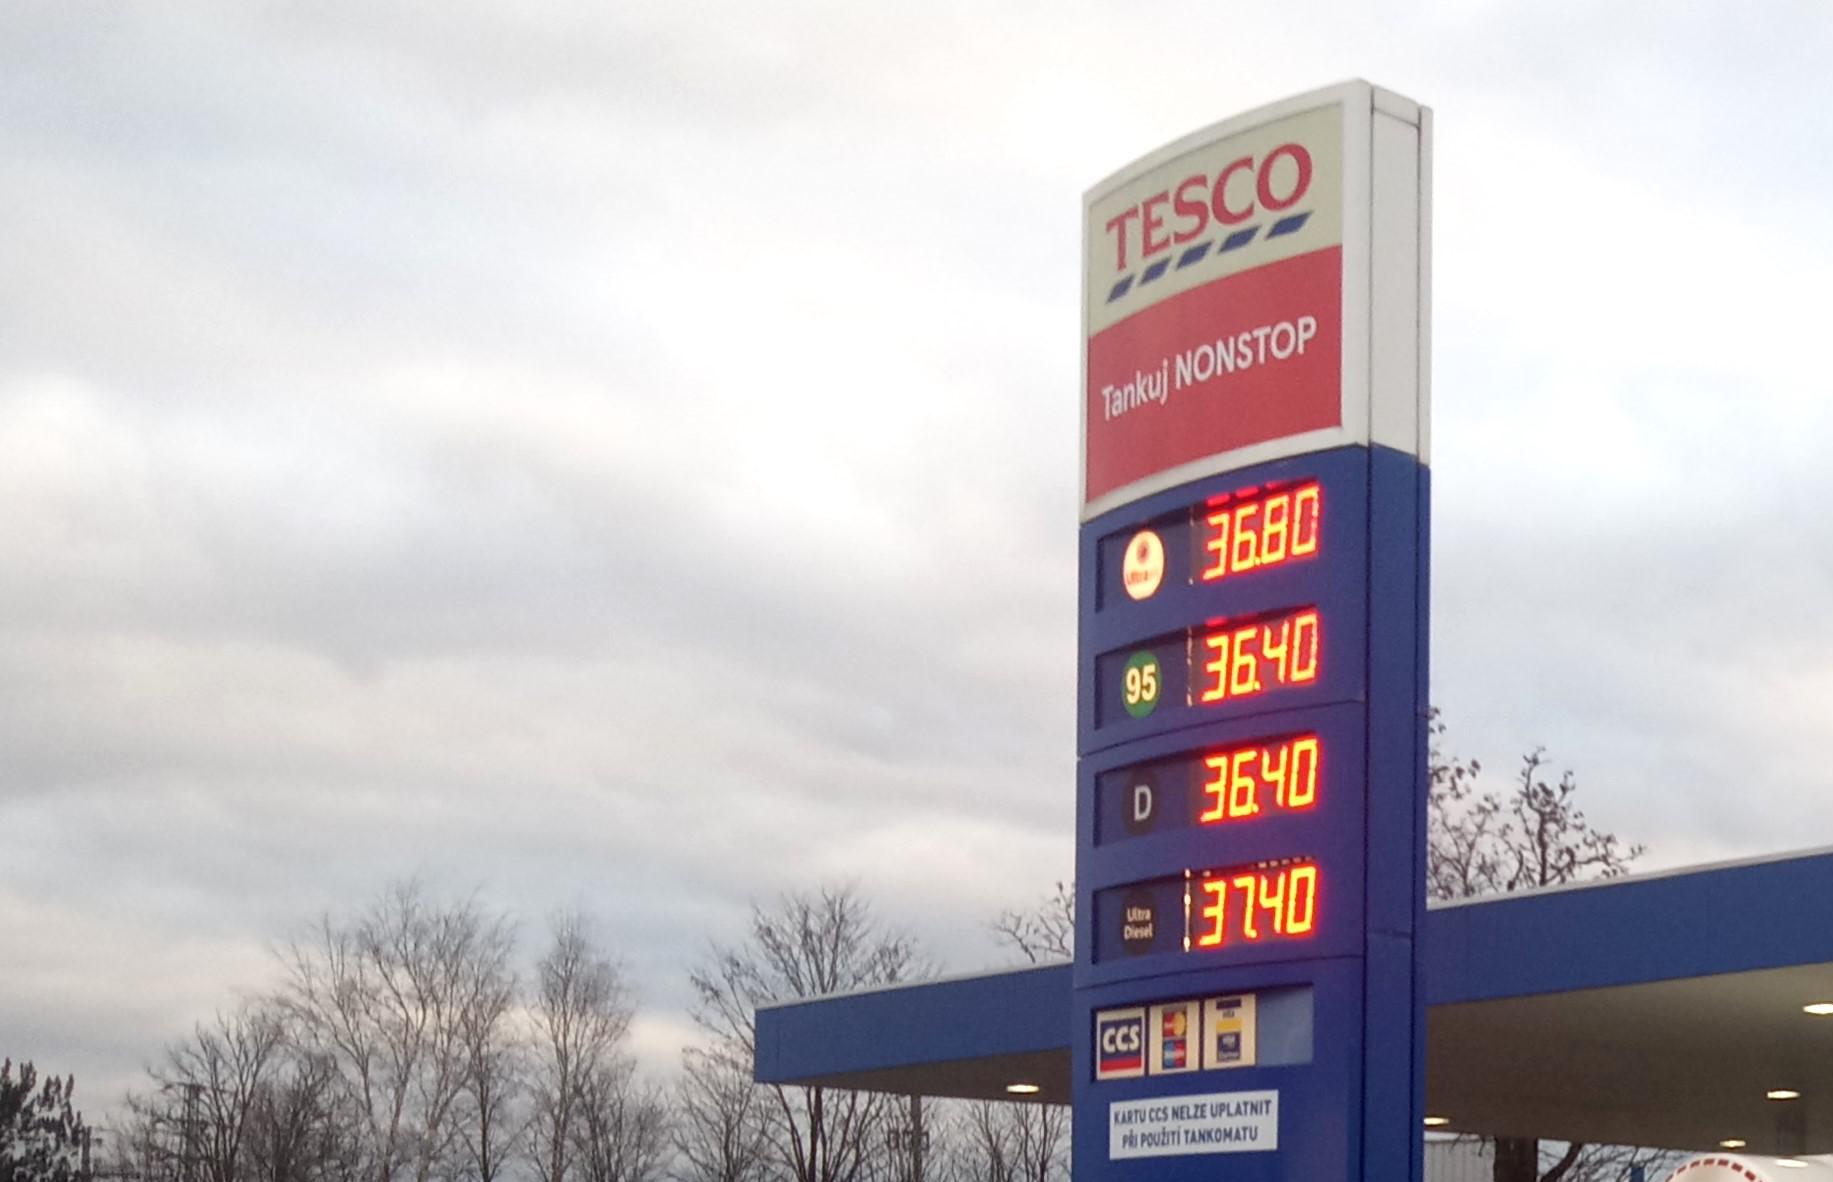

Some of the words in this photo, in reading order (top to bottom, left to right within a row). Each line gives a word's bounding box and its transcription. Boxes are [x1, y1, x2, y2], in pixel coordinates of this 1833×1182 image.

[1105, 142, 1313, 271] TESCO
[1102, 359, 1169, 421] Tankuj
[1175, 316, 1318, 390] NONSTOP
[1202, 484, 1320, 581] 36.80
[1201, 611, 1319, 703] 36.40
[1125, 664, 1157, 705] 95
[1200, 736, 1319, 823] 36.40
[1133, 785, 1153, 821] D
[1123, 923, 1154, 940] Diesel
[1126, 907, 1151, 923] Ultra
[1102, 1025, 1141, 1054] CCS
[1113, 1108, 1146, 1126] KARTU
[1149, 1106, 1169, 1123] CCS
[1171, 1103, 1207, 1121] NELZE
[1210, 1099, 1272, 1118] UPLATNIT
[1122, 1129, 1137, 1149] PŘI
[1140, 1126, 1181, 1147] POUŽITÍ
[1184, 1125, 1258, 1145] TANKOMATU
